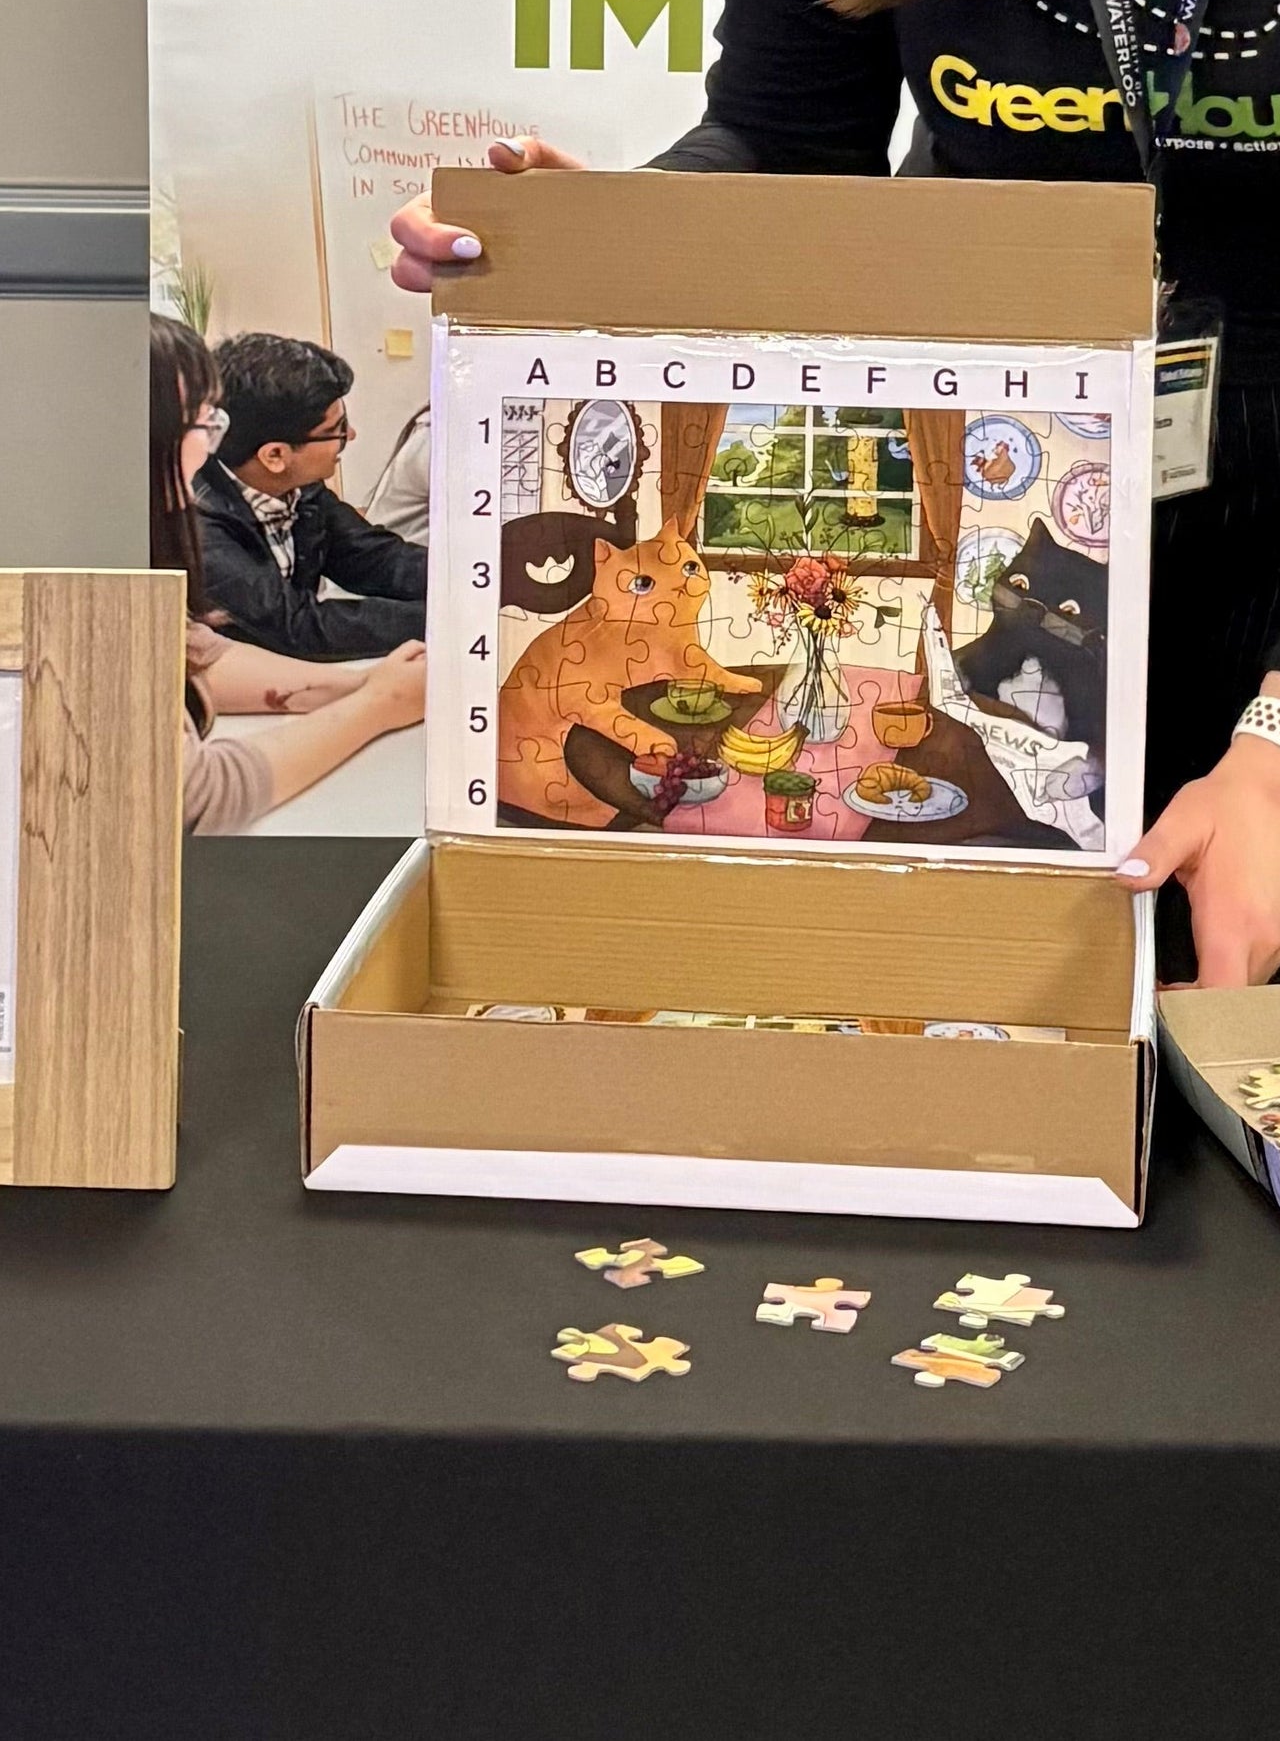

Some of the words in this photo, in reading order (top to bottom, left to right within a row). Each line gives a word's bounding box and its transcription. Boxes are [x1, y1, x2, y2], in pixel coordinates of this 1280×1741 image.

[333, 92, 387, 129] THE
[352, 175, 375, 198] IN
[526, 357, 550, 386] A
[595, 359, 617, 387] B
[663, 361, 686, 389] C
[732, 363, 755, 390] D
[801, 364, 821, 393] E
[867, 366, 887, 394] F
[933, 368, 958, 396] G
[1005, 369, 1028, 398] H
[1074, 371, 1089, 400] I
[478, 417, 490, 444] 1
[472, 489, 492, 517] 2
[471, 561, 491, 589] 3
[468, 634, 491, 661] 4
[469, 706, 488, 733] 5
[468, 778, 487, 806] 6
